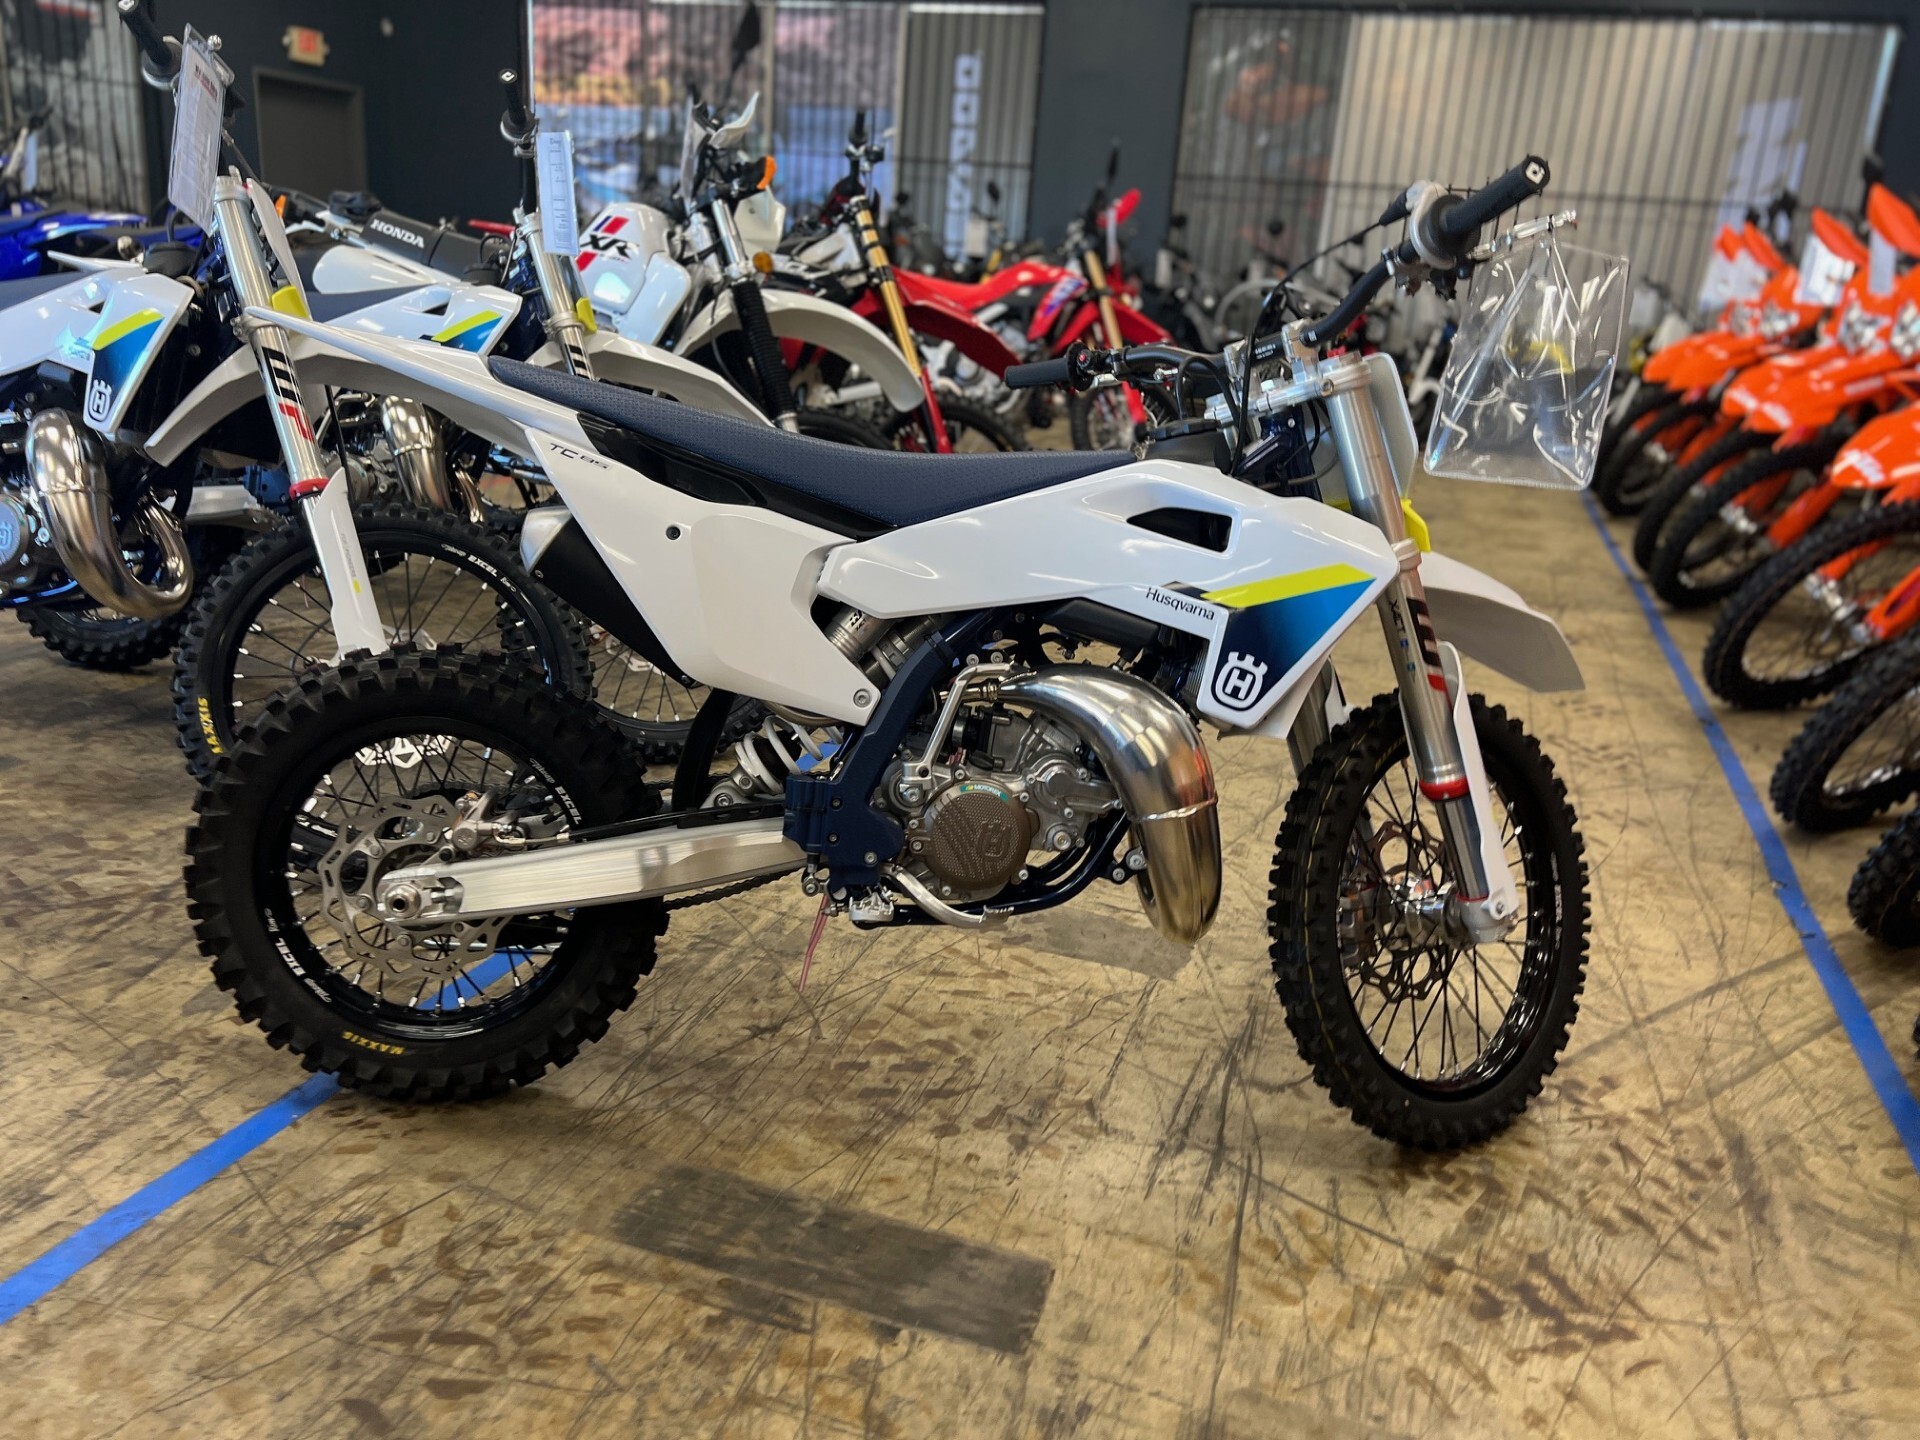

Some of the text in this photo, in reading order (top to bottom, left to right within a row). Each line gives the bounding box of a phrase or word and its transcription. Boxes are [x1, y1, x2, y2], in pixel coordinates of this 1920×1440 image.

[370, 219, 424, 248] HONDA
[550, 442, 608, 469] TC 85
[467, 554, 497, 577] EXCEL
[1145, 586, 1215, 621] Husqvarna
[554, 785, 582, 825] EXCEL
[275, 937, 307, 977] EXCEL
[341, 1031, 406, 1055] MAXXIS
